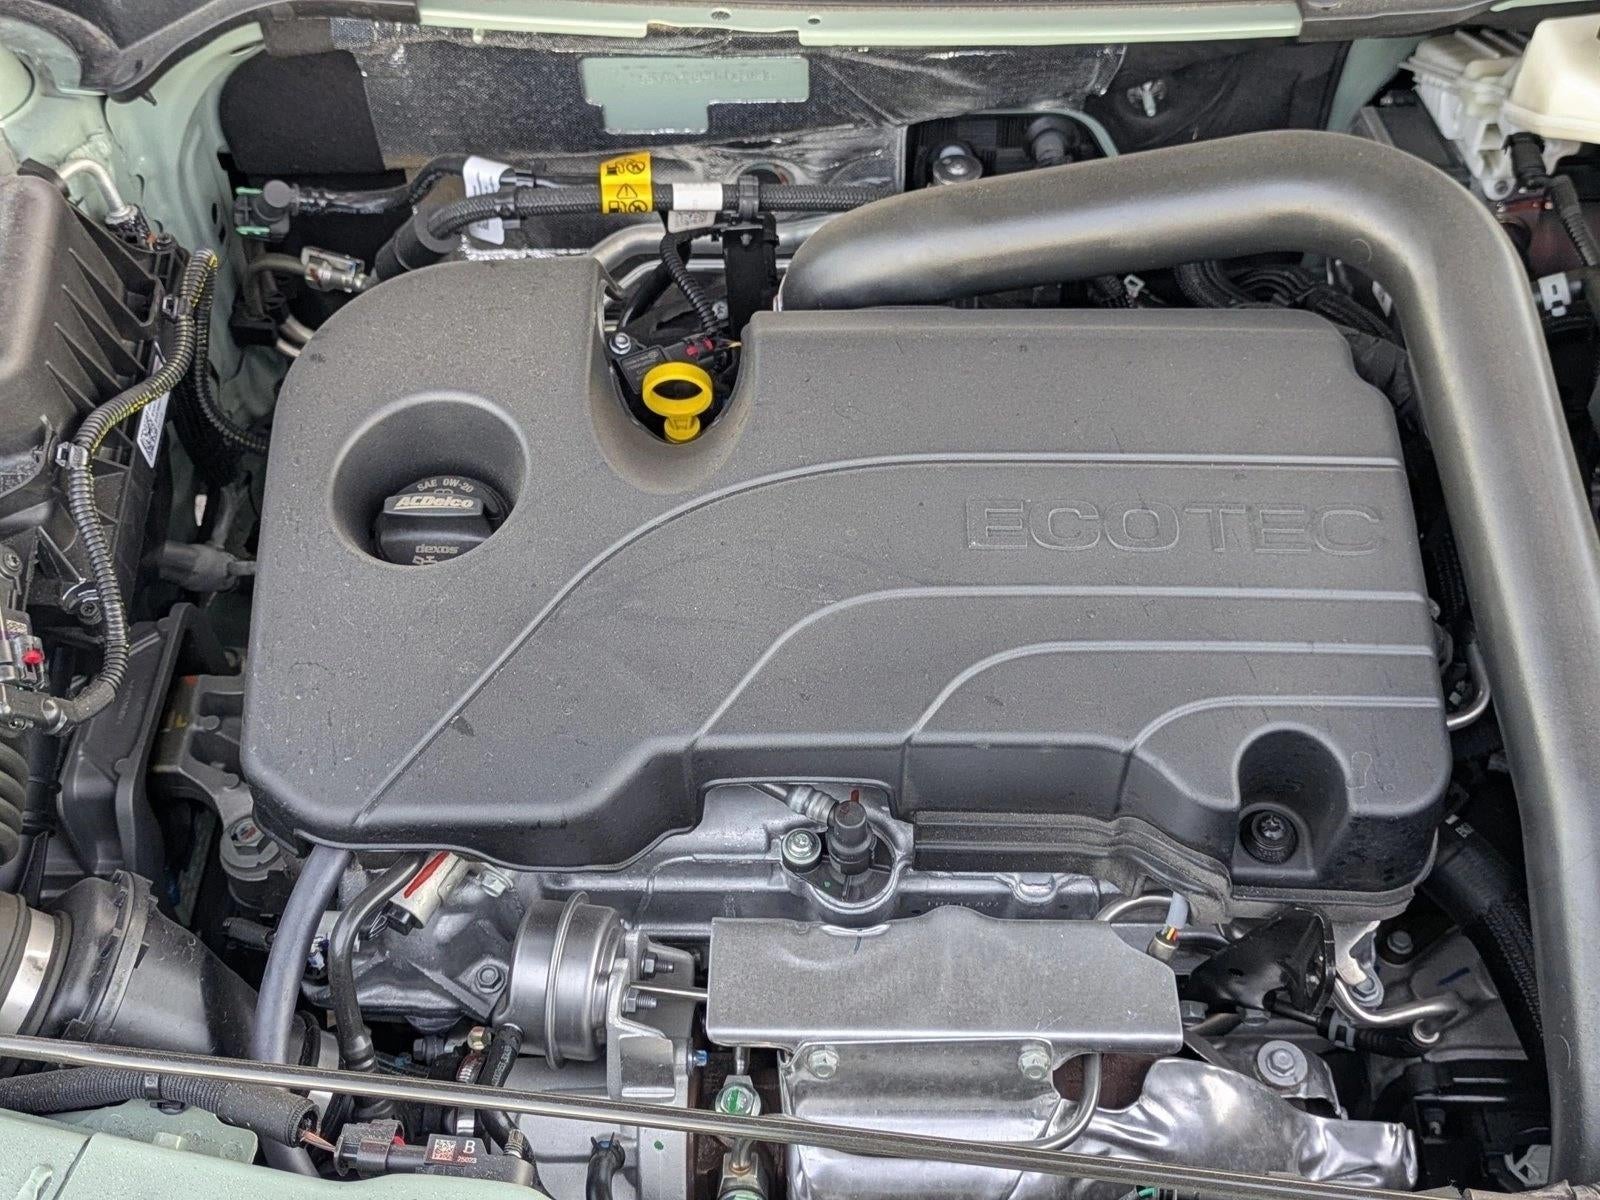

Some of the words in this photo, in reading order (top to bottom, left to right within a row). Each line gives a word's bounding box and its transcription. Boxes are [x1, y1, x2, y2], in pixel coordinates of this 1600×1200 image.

[417, 479, 437, 491] SAE
[443, 478, 474, 493] 0W-20
[394, 496, 474, 509] ACDelco
[966, 499, 1384, 556] ECOTEC
[415, 544, 459, 554] dexos
[463, 1140, 476, 1154] B
